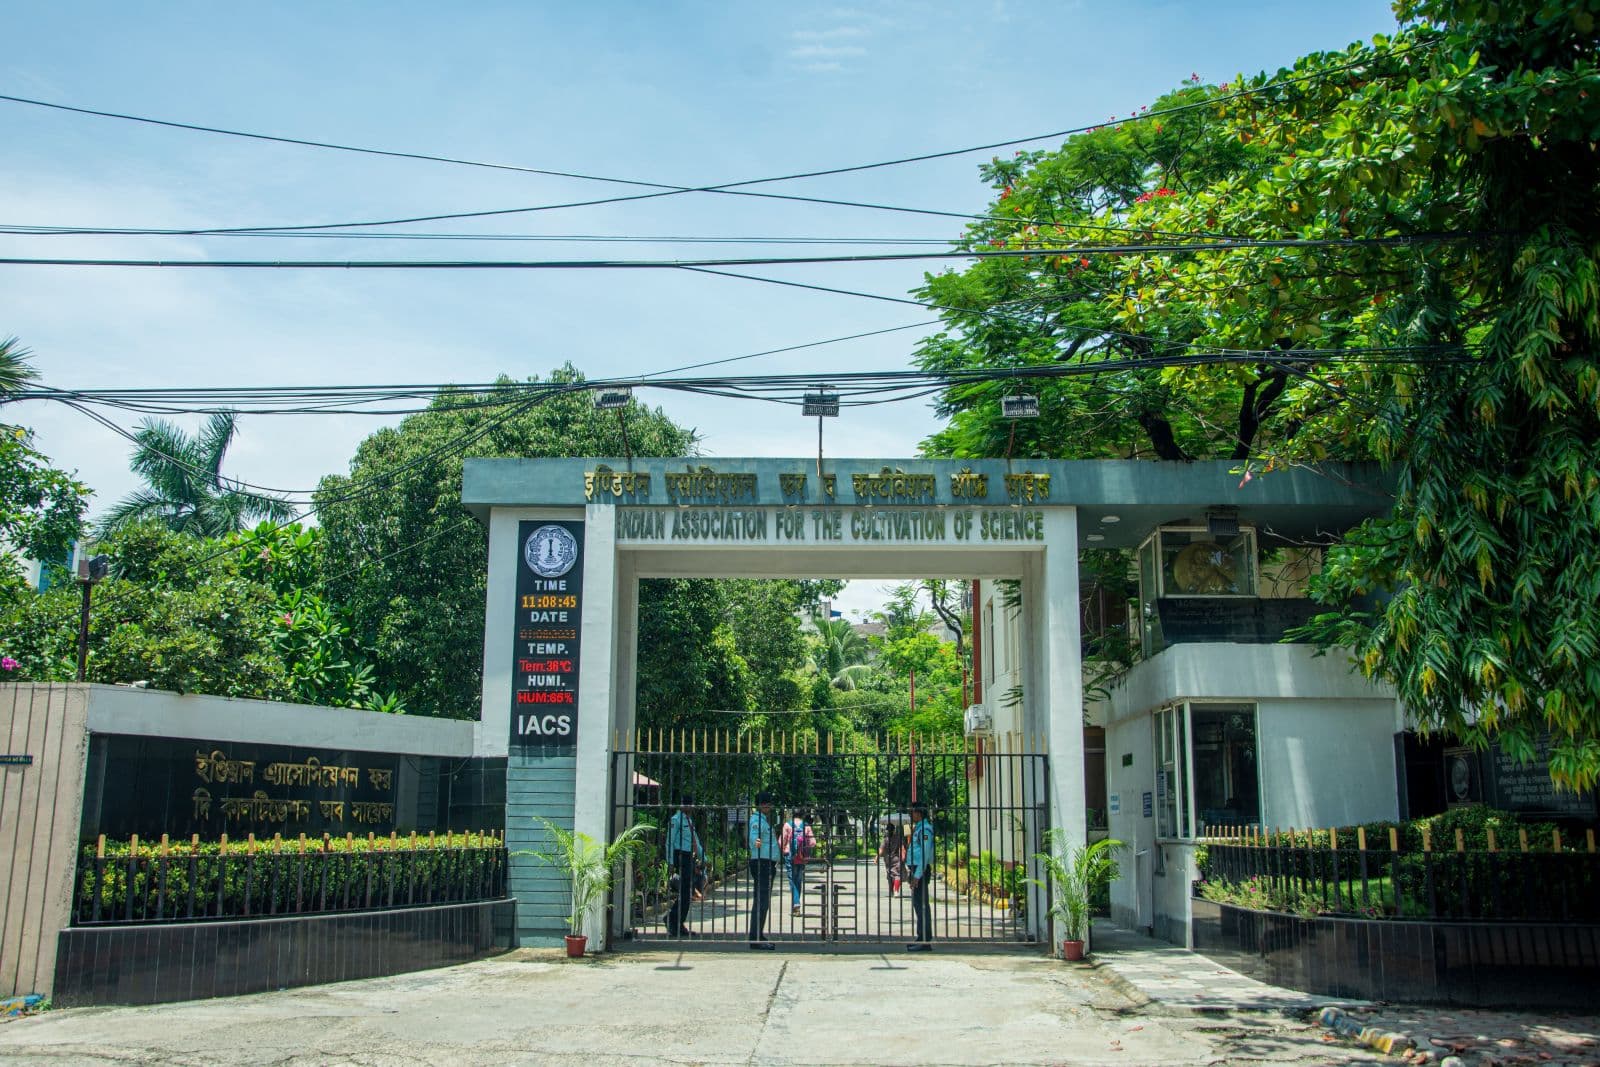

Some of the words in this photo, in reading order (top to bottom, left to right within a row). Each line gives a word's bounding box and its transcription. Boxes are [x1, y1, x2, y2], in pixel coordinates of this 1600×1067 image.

[617, 511, 665, 539] INDIAN
[672, 511, 767, 539] ASSOCIATION
[776, 511, 805, 539] FOR
[812, 511, 842, 539] THE
[851, 511, 945, 540] CULTIVATION
[953, 511, 973, 540] OF
[980, 511, 1044, 540] SCIENCE
[534, 580, 567, 591] TIME
[522, 595, 577, 608] 11:08:45
[531, 611, 568, 622] DATE
[528, 643, 568, 654] TEMP.
[527, 675, 566, 686] HUMI.
[518, 715, 571, 735] IACS
